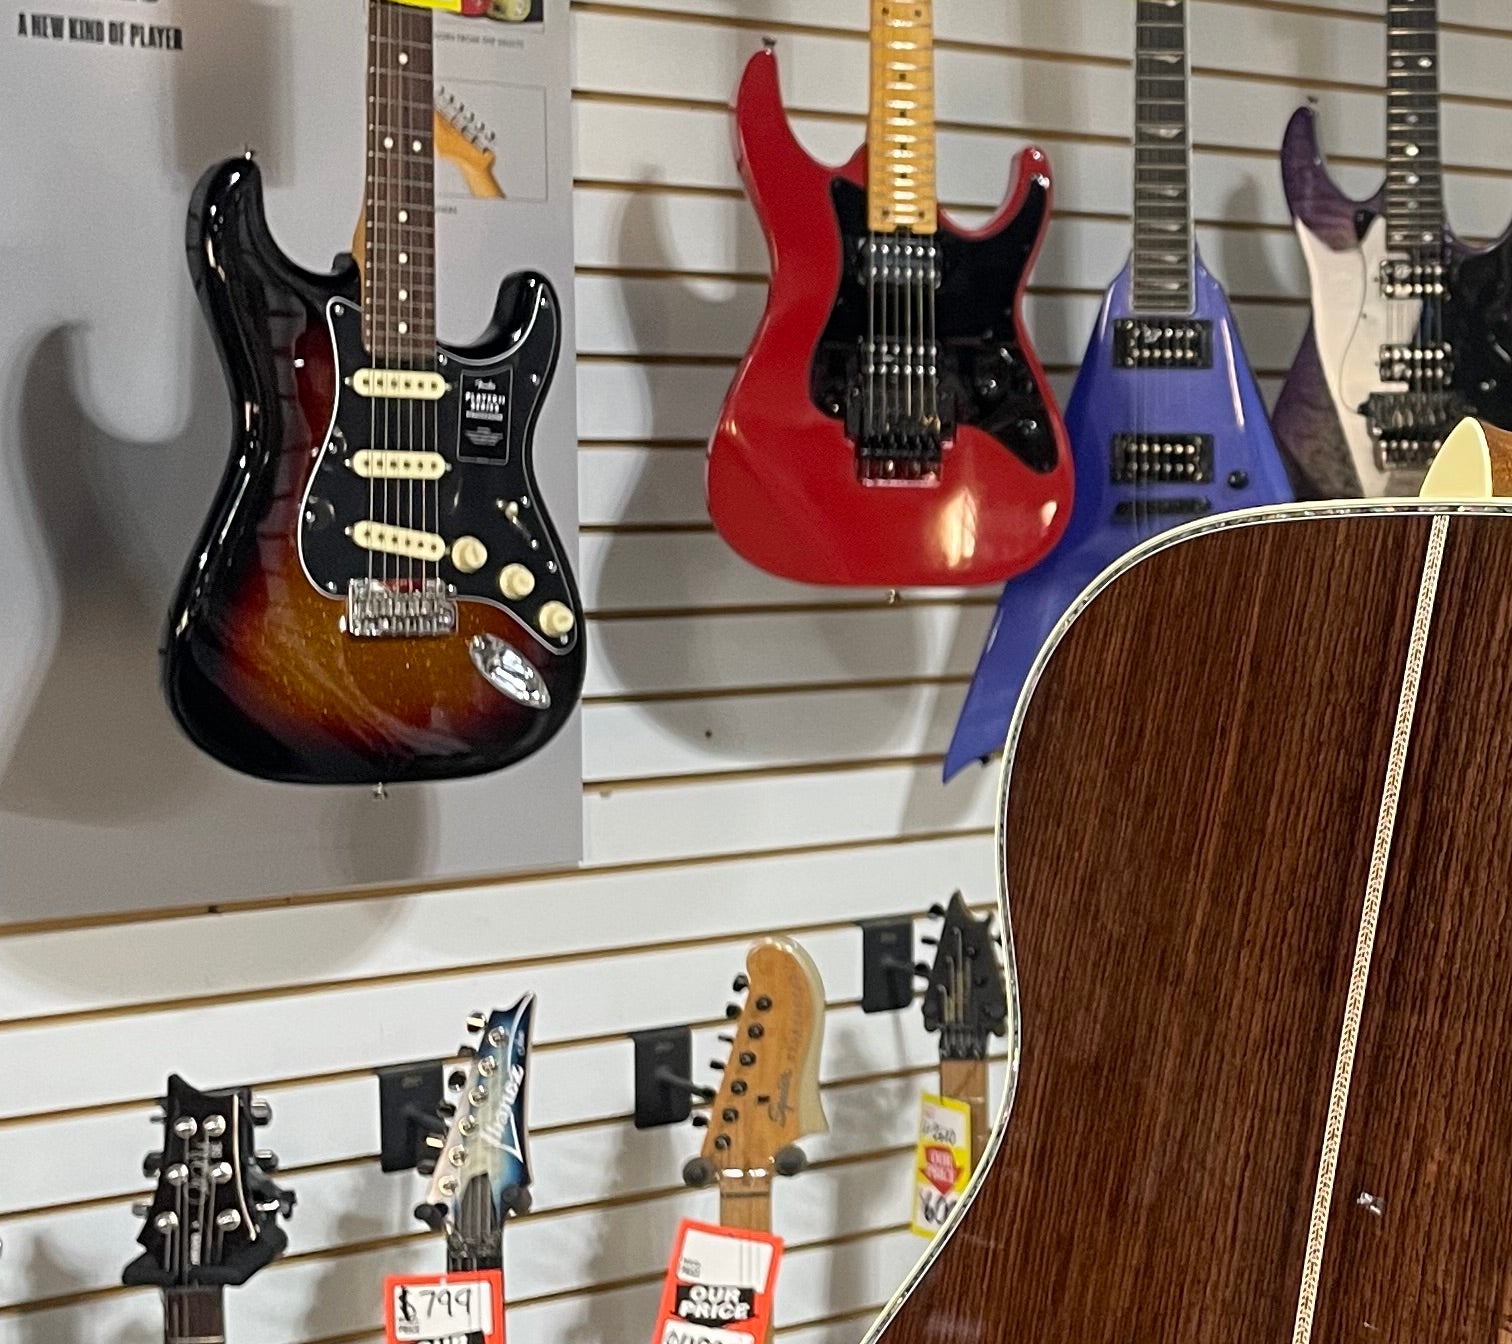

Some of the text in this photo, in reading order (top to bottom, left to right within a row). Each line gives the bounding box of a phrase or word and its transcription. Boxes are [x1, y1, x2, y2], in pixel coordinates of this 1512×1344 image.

[17, 12, 184, 51] A NEW KIND OF PLAYER
[688, 1285, 742, 1304] OUR
[678, 1300, 751, 1321] PRICE
